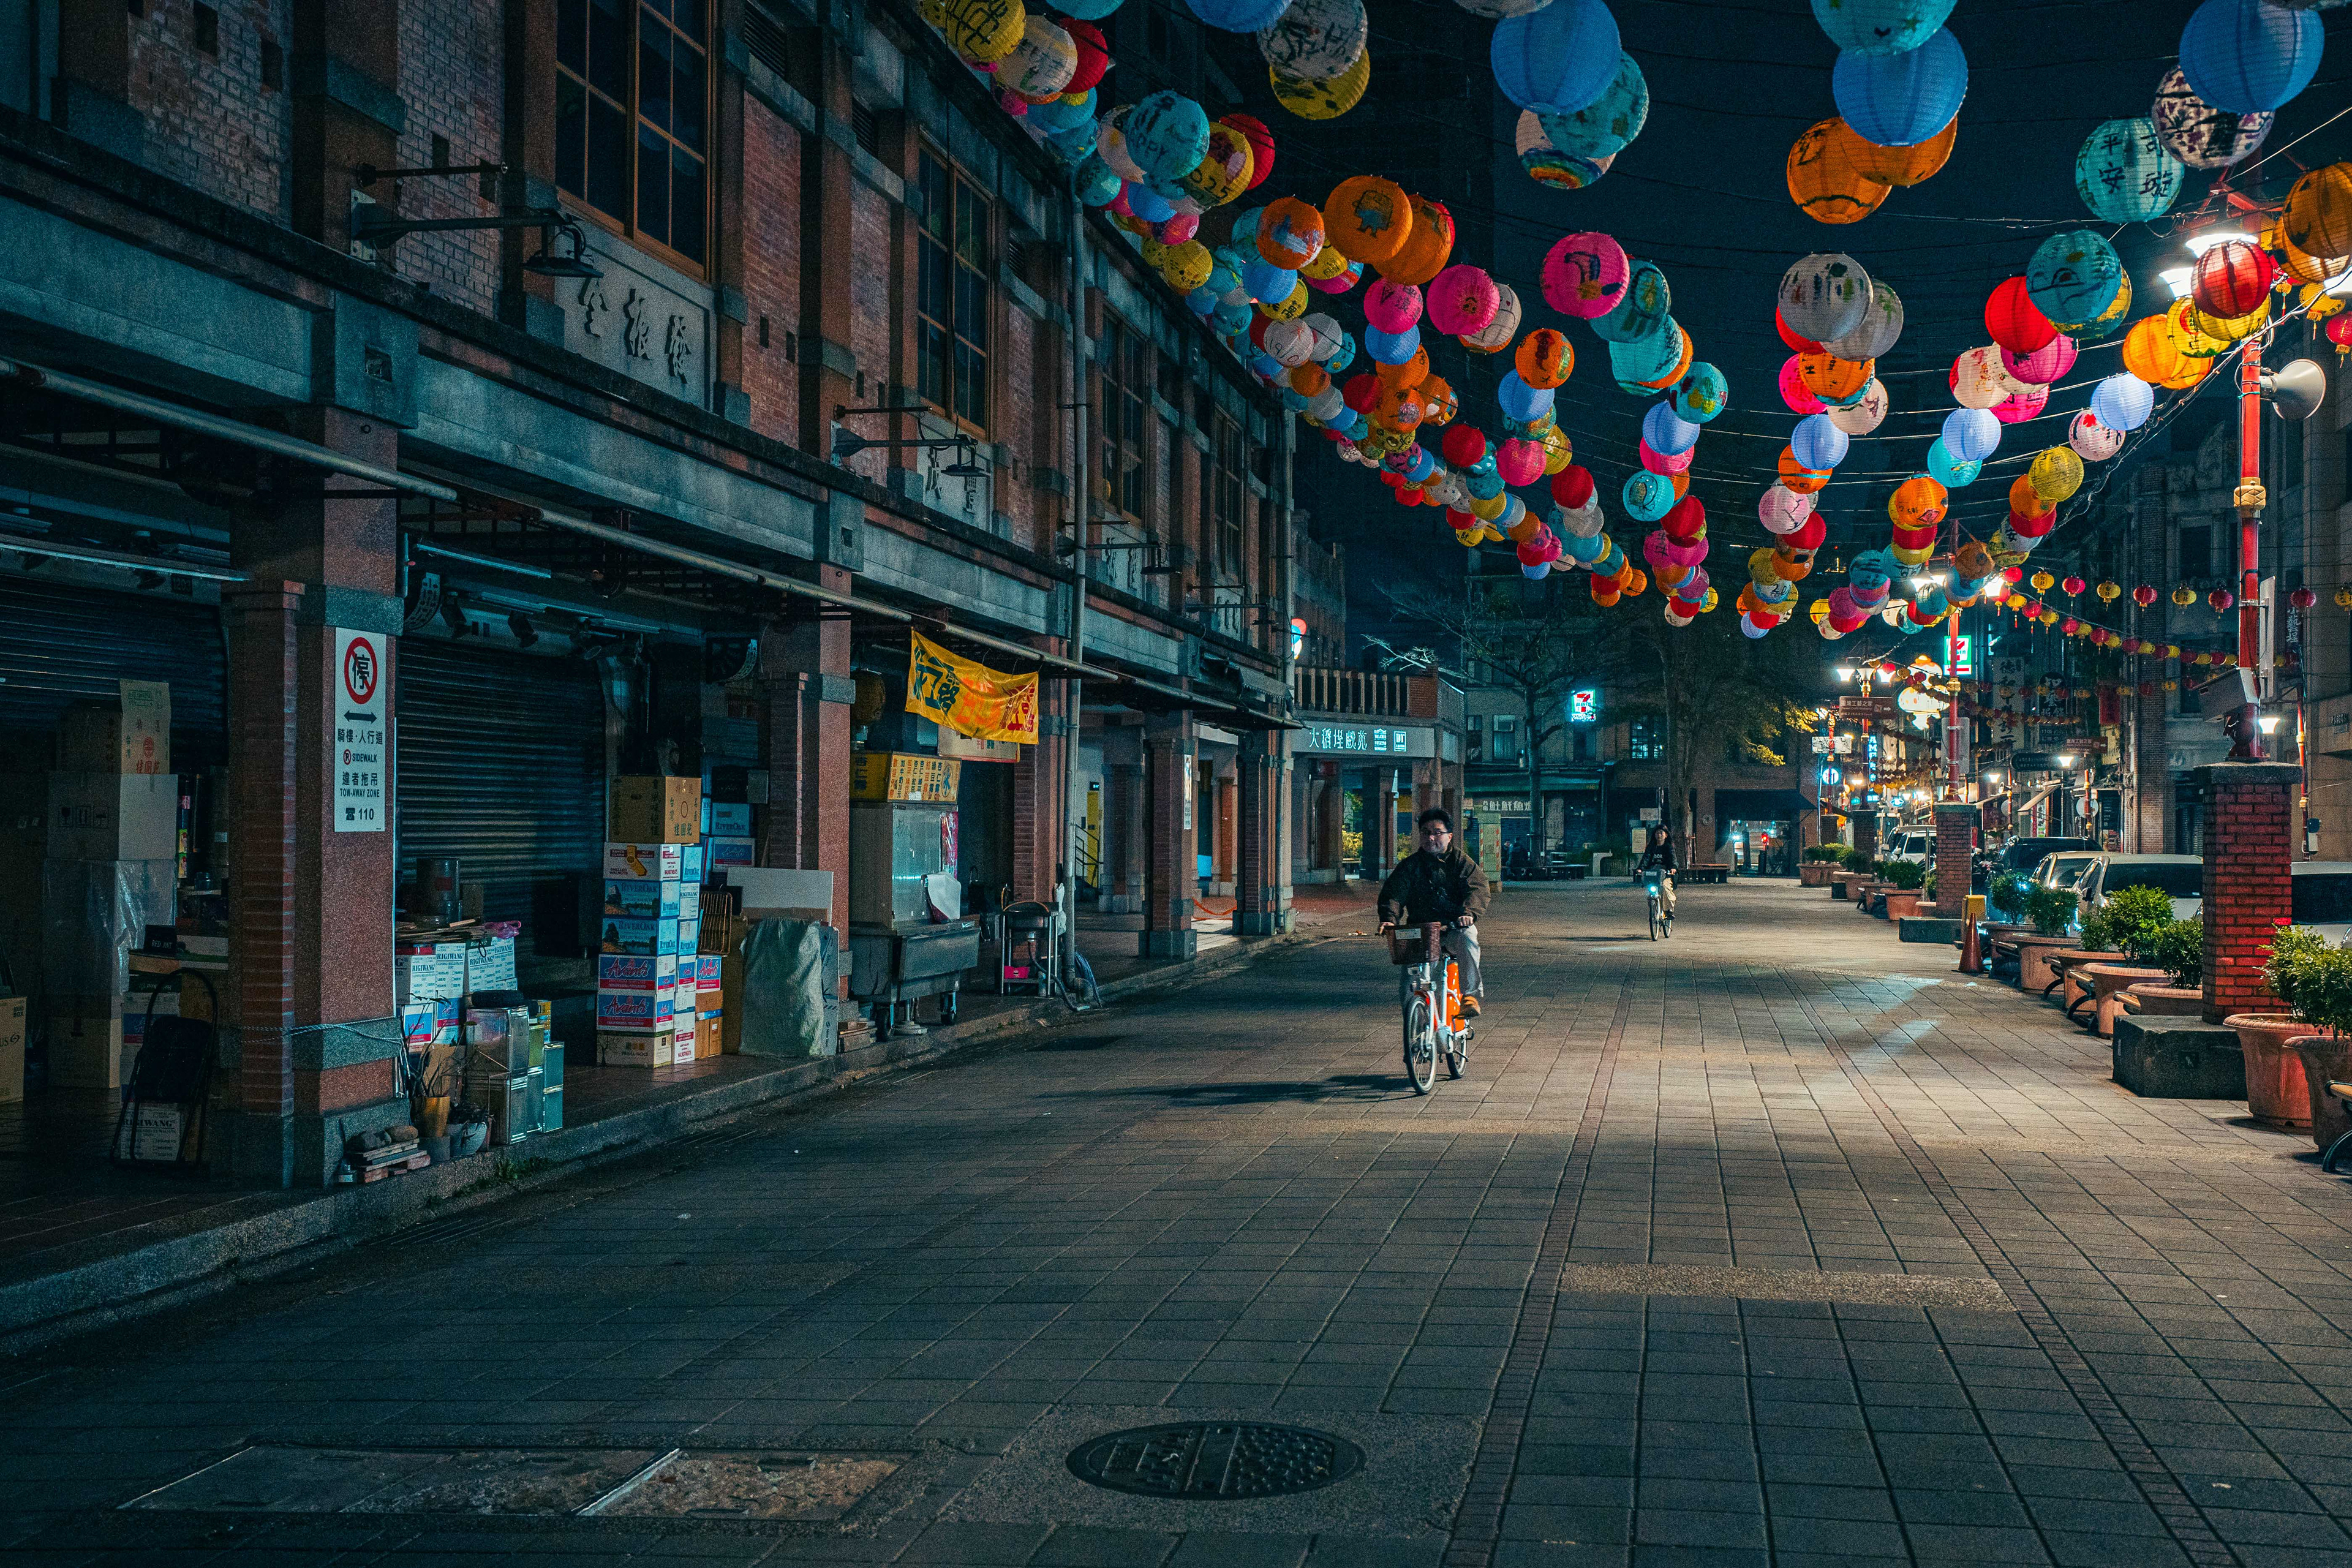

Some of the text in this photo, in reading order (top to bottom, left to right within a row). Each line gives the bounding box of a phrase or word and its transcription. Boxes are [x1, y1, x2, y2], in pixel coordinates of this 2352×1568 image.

[2098, 132, 2126, 194] 平安
[352, 653, 370, 690] 停
[352, 753, 377, 764] SIDEWALK
[342, 771, 379, 786] 違者拖吊
[367, 788, 380, 798] ZONE
[358, 807, 375, 821] 110
[494, 944, 513, 954] IGIWANG
[605, 957, 650, 978] Avanti
[603, 995, 648, 1015] Avanti
